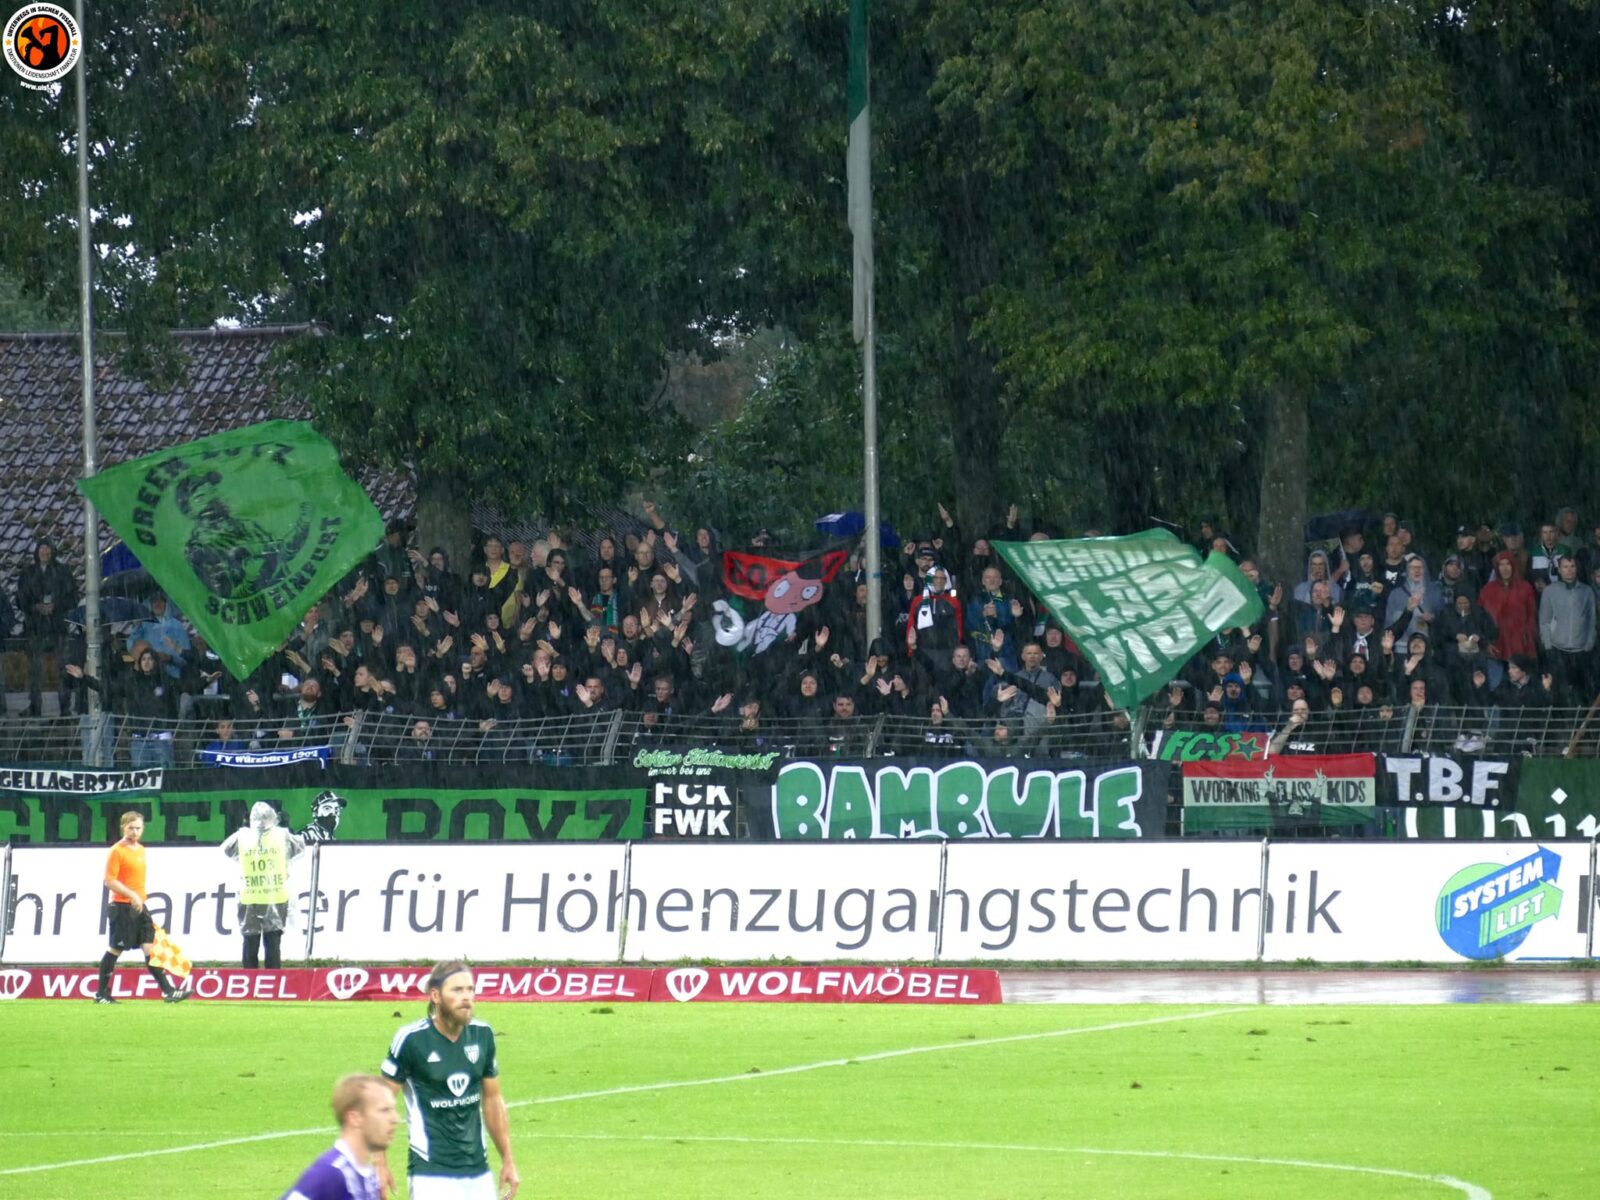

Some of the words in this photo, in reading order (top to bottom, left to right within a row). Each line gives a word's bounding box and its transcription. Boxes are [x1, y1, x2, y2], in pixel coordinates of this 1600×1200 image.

[655, 782, 732, 806] FCK
[771, 760, 1142, 839] BAMBULE
[1190, 779, 1261, 804] WORKING
[1326, 779, 1366, 803] KIDS
[1385, 756, 1510, 807] T.B.F.
[654, 807, 731, 837] FWK
[1453, 856, 1545, 919] SYSTEM
[380, 868, 480, 935] für
[500, 868, 1344, 951] Höhenzugangstechnik
[1495, 891, 1546, 934] LIFT
[720, 967, 980, 1000] WOLFMÖBEL
